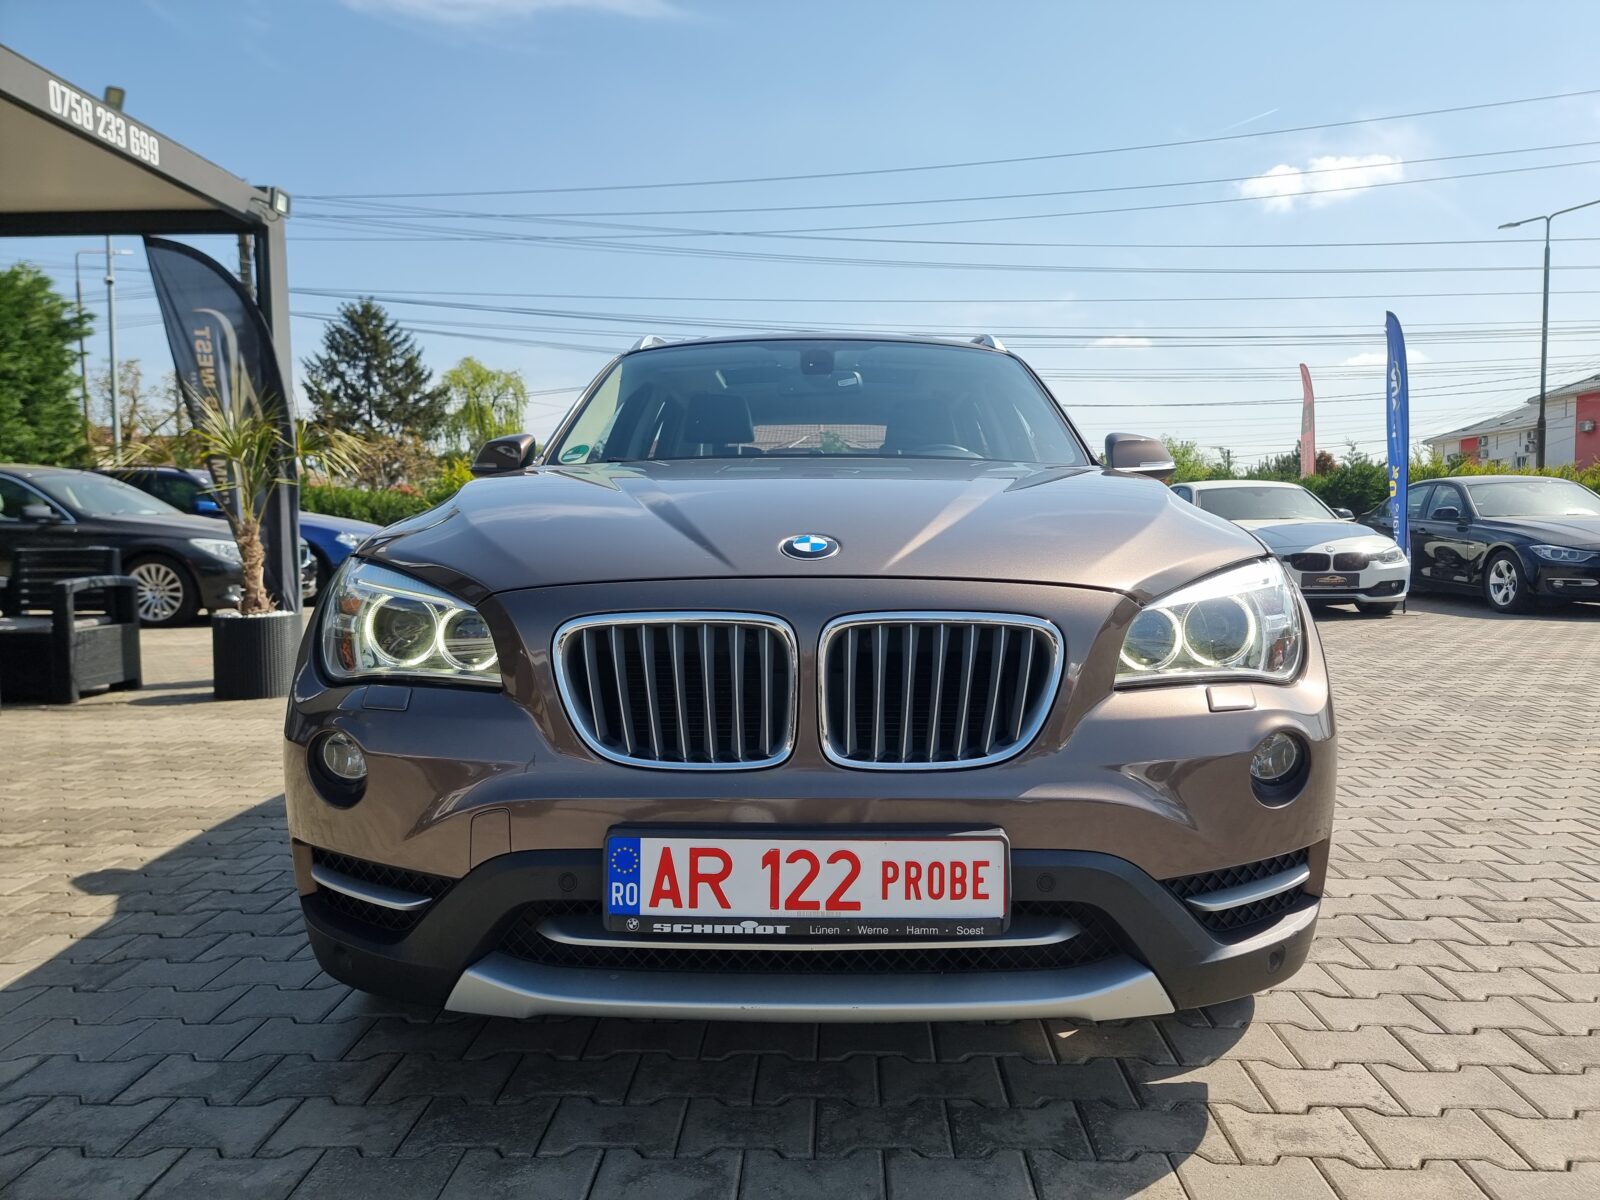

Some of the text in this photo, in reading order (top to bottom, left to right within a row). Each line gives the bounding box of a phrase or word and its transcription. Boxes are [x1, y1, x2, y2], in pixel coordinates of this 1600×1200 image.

[48, 79, 159, 166] 0758 233 699
[611, 846, 990, 912] RO AR 122 PROBE
[808, 925, 841, 936] Lünen
[857, 925, 889, 936] Werne
[906, 926, 939, 936] Hamm
[956, 926, 985, 936] Soest
